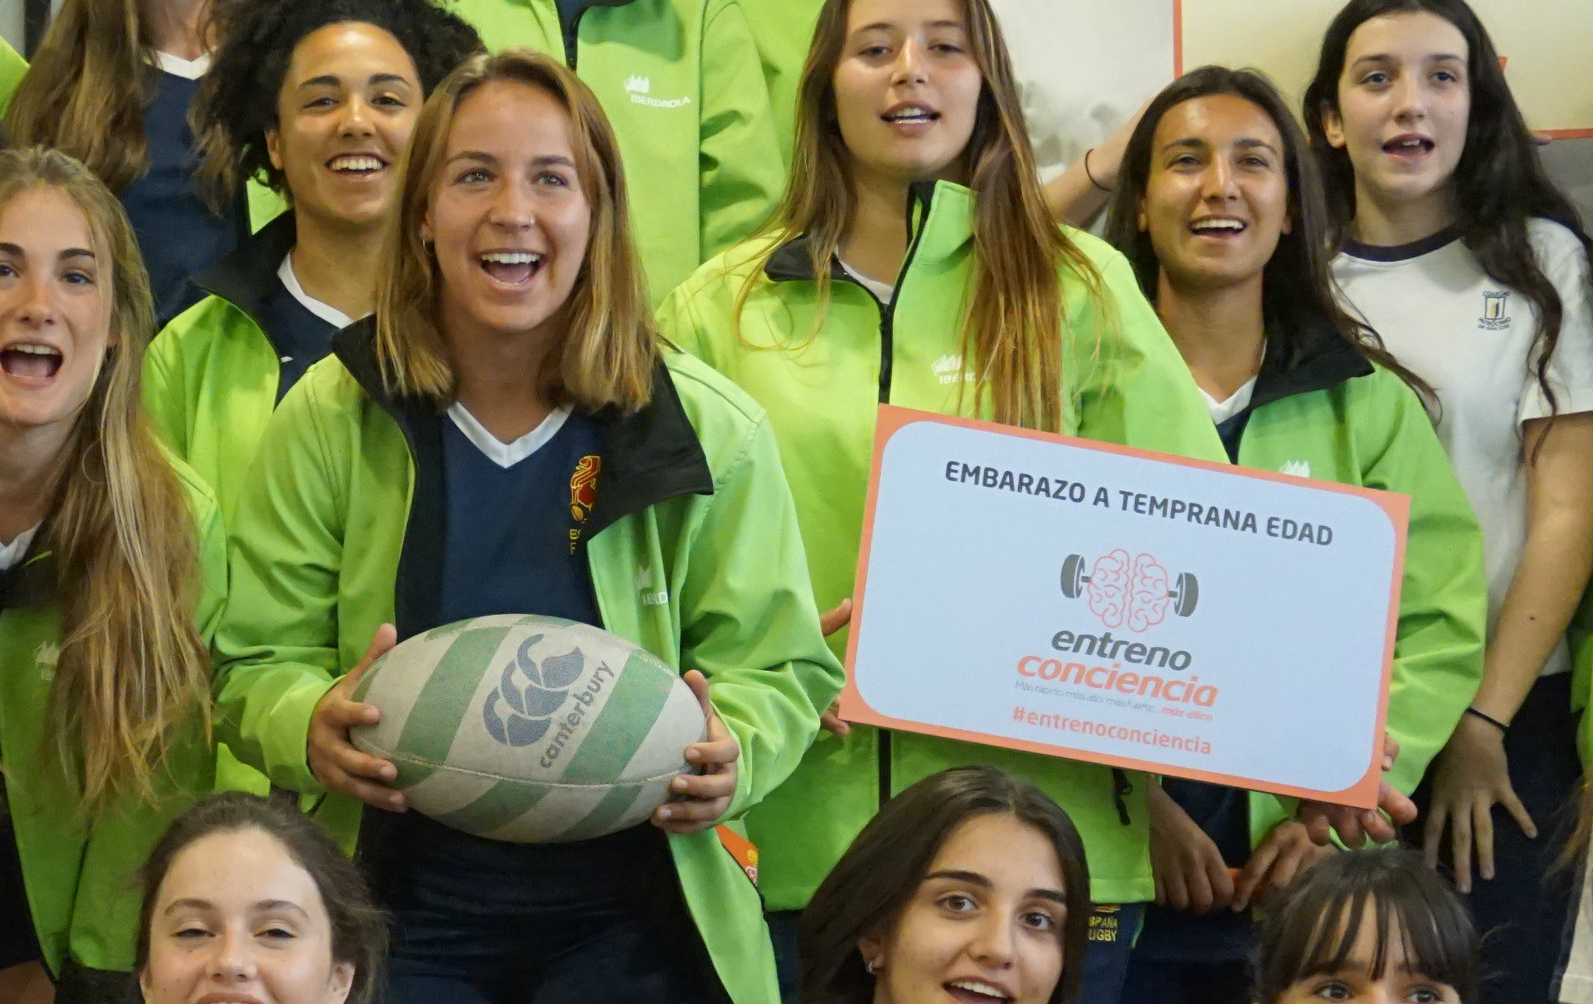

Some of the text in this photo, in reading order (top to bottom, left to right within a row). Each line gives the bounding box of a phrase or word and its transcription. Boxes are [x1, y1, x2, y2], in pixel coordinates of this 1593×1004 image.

[945, 460, 1333, 546] EMBARAZO A TEMPRANA EDAD
[1051, 630, 1192, 671] entreno
[1016, 654, 1219, 707] conciencia
[540, 660, 615, 769] canterbury
[1012, 706, 1212, 755] #entrenoconciencia
[1088, 915, 1118, 929] SPAÑA
[1088, 929, 1118, 942] UGBY
